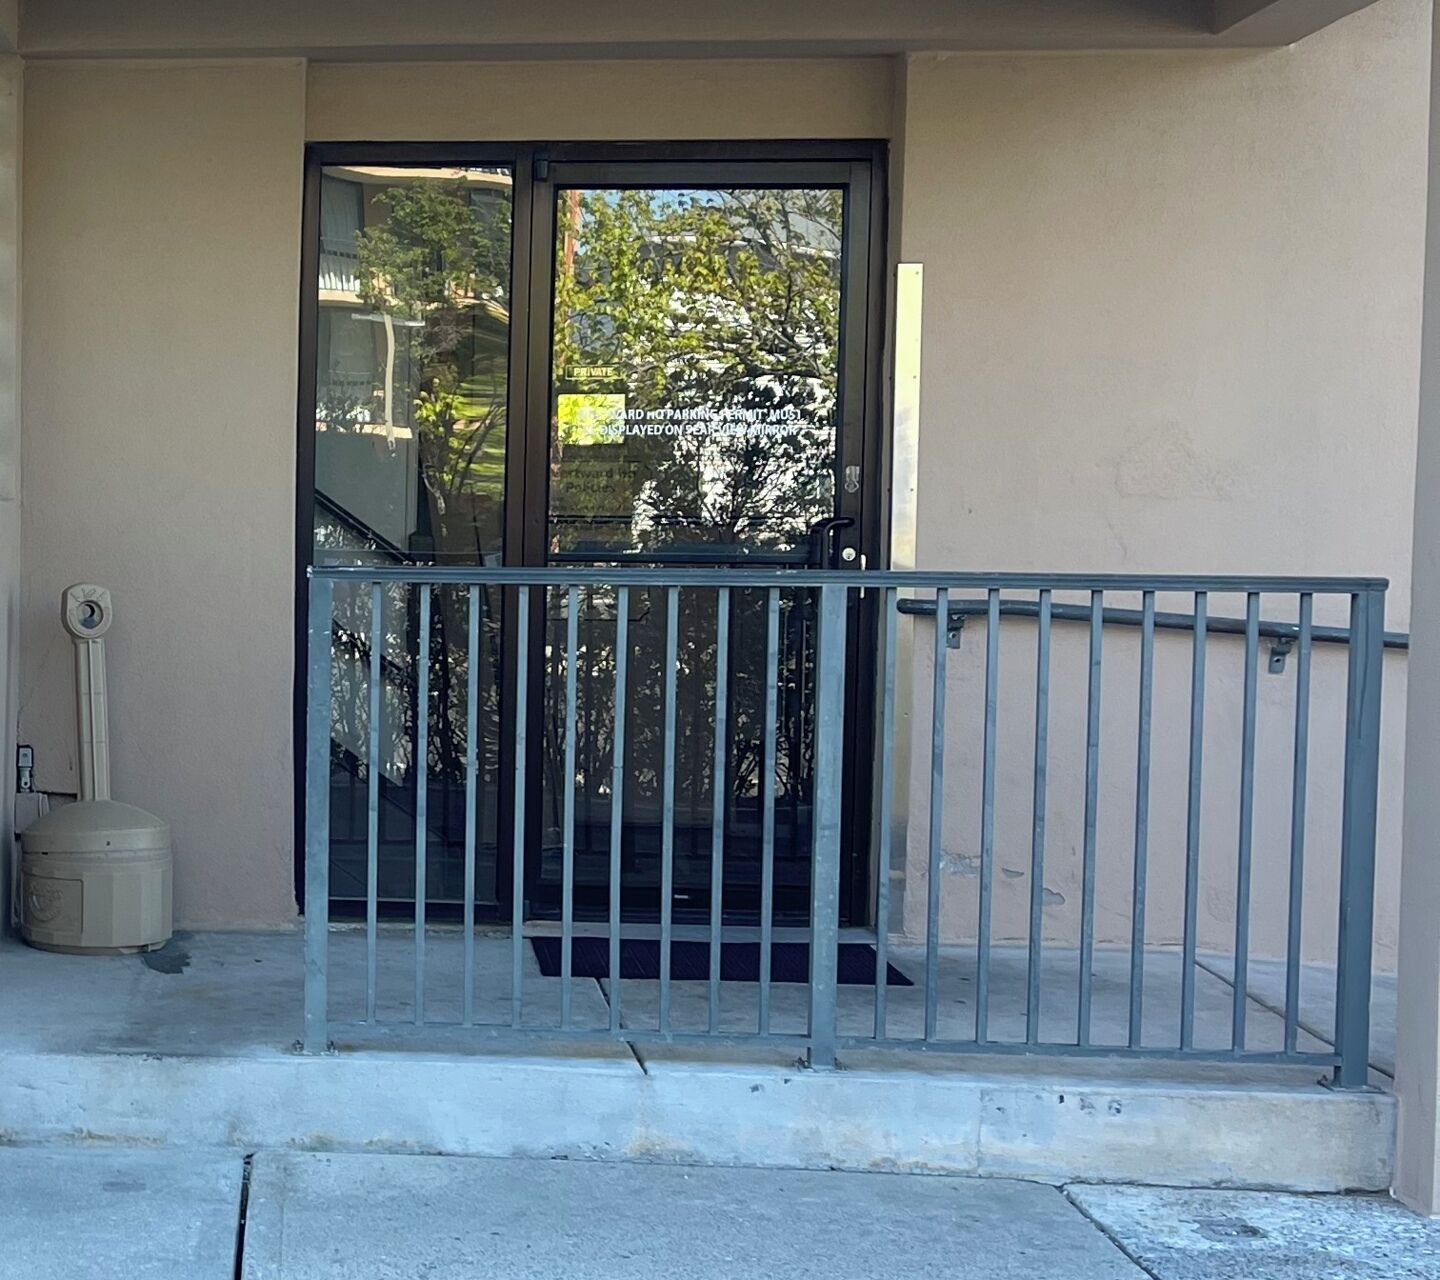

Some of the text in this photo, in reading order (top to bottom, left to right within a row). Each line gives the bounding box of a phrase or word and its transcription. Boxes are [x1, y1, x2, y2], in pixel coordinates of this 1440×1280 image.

[573, 367, 614, 376] PRIVATE
[667, 408, 716, 420] PARKING
[599, 424, 662, 436] DISPLAYED
[665, 424, 682, 436] ON
